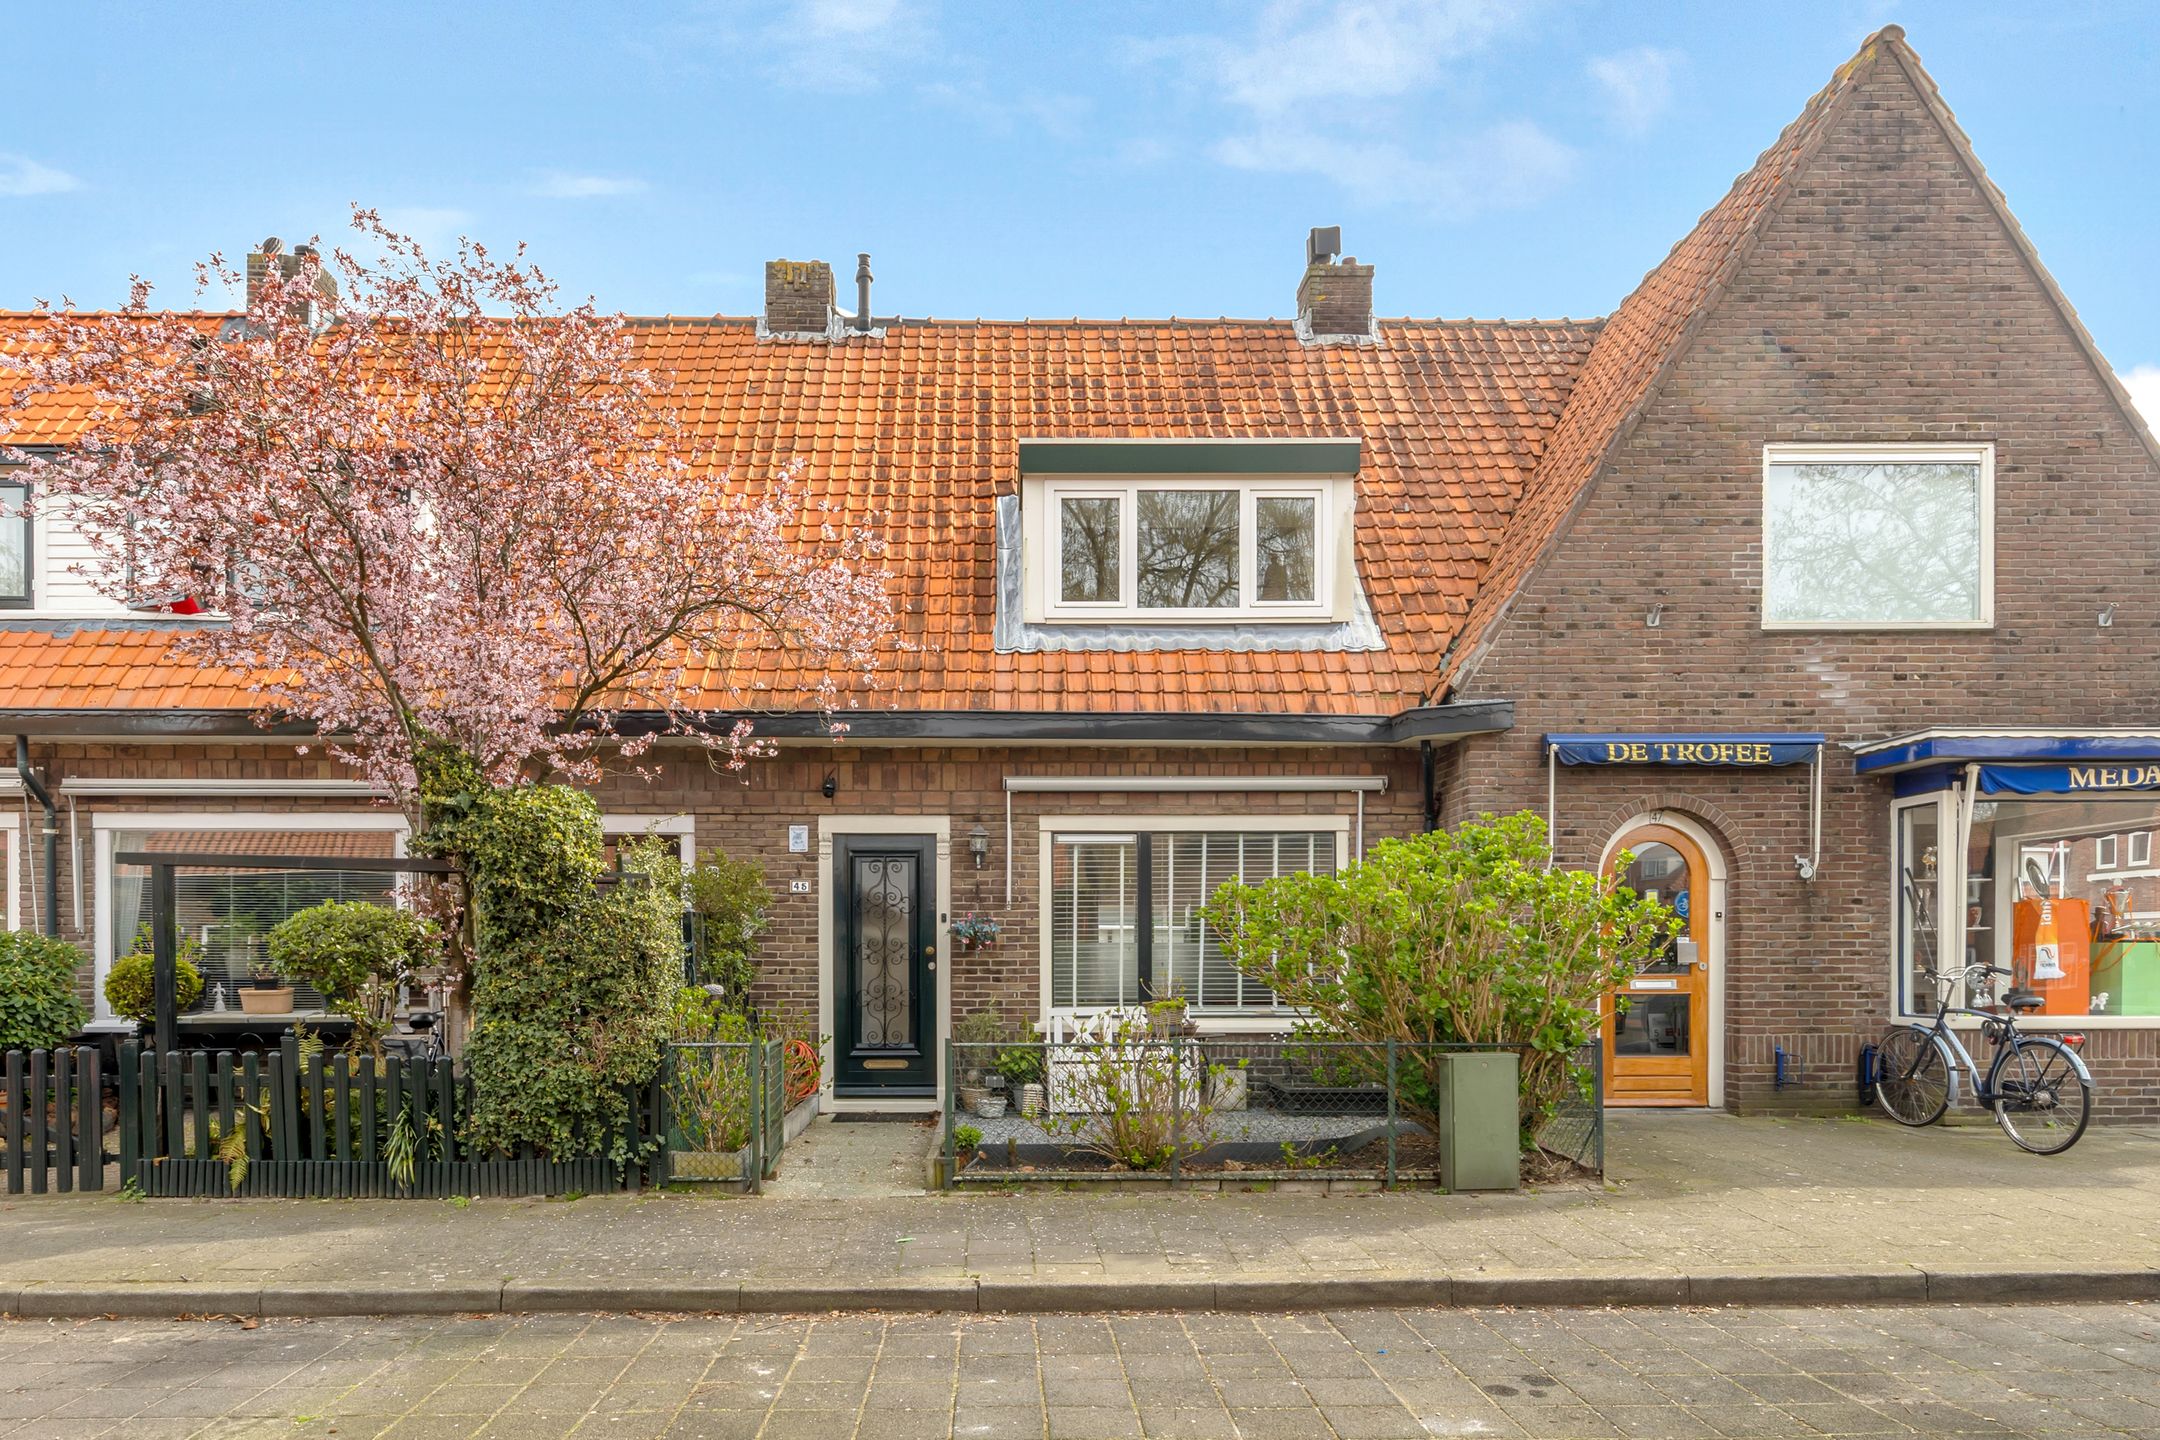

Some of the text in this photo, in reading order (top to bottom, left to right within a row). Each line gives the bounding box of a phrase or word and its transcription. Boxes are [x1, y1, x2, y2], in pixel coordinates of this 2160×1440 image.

[1606, 743, 1772, 762] DE TROFEE
[2068, 765, 2160, 788] MEDA
[1652, 811, 1663, 822] 47
